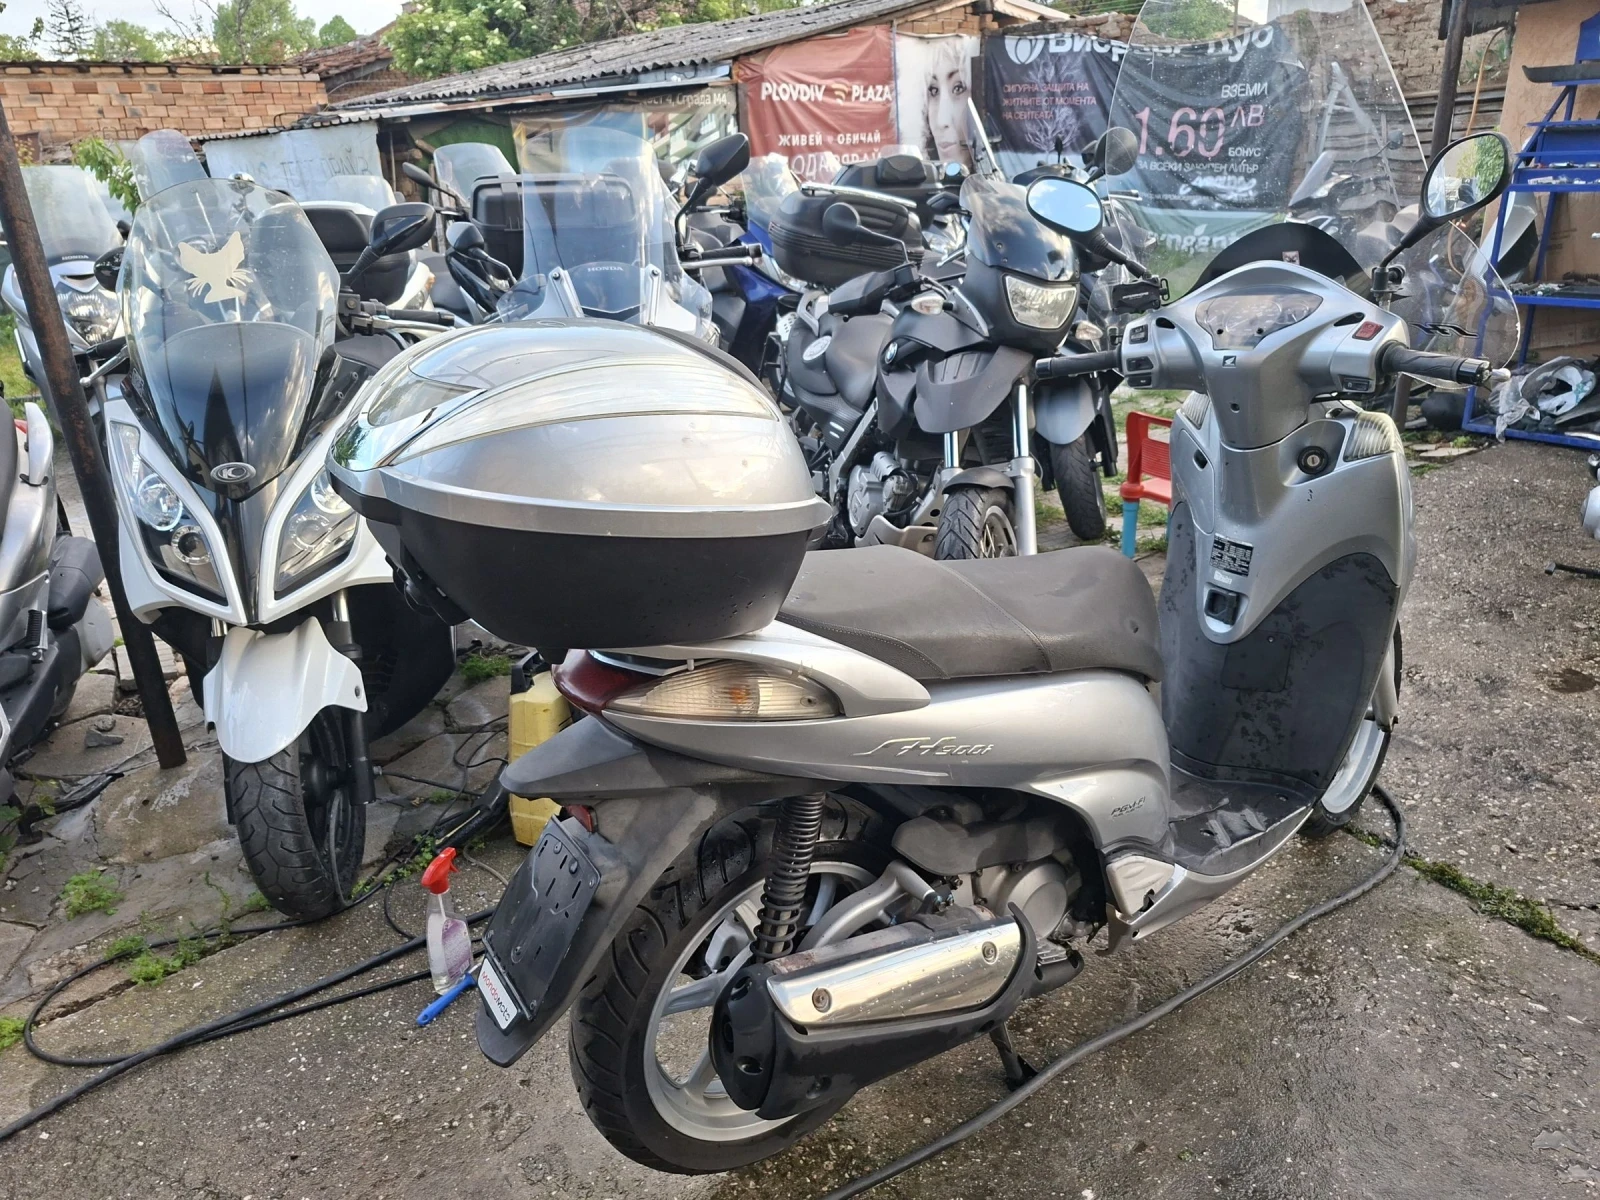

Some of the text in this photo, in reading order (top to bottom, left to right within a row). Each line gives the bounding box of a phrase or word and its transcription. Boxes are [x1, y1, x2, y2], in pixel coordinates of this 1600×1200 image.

[761, 82, 893, 102] PLOVDIV PLAZA
[1003, 82, 1090, 93] СИГУРНА ЗАЩИТА НА
[1221, 82, 1268, 98] ВЗЕМИ
[1043, 97, 1054, 105] ОТ
[1055, 96, 1097, 106] МОМЕНТА
[1003, 112, 1012, 120] НА
[1230, 104, 1264, 128] ЛВ
[778, 129, 881, 147] ЖИВЕЙ ОБИЧАЙ
[1135, 106, 1225, 157] 1.60
[1228, 147, 1262, 157] БОНУС
[1138, 160, 1148, 170] ЗА
[1150, 161, 1182, 172] ВСЕКИ
